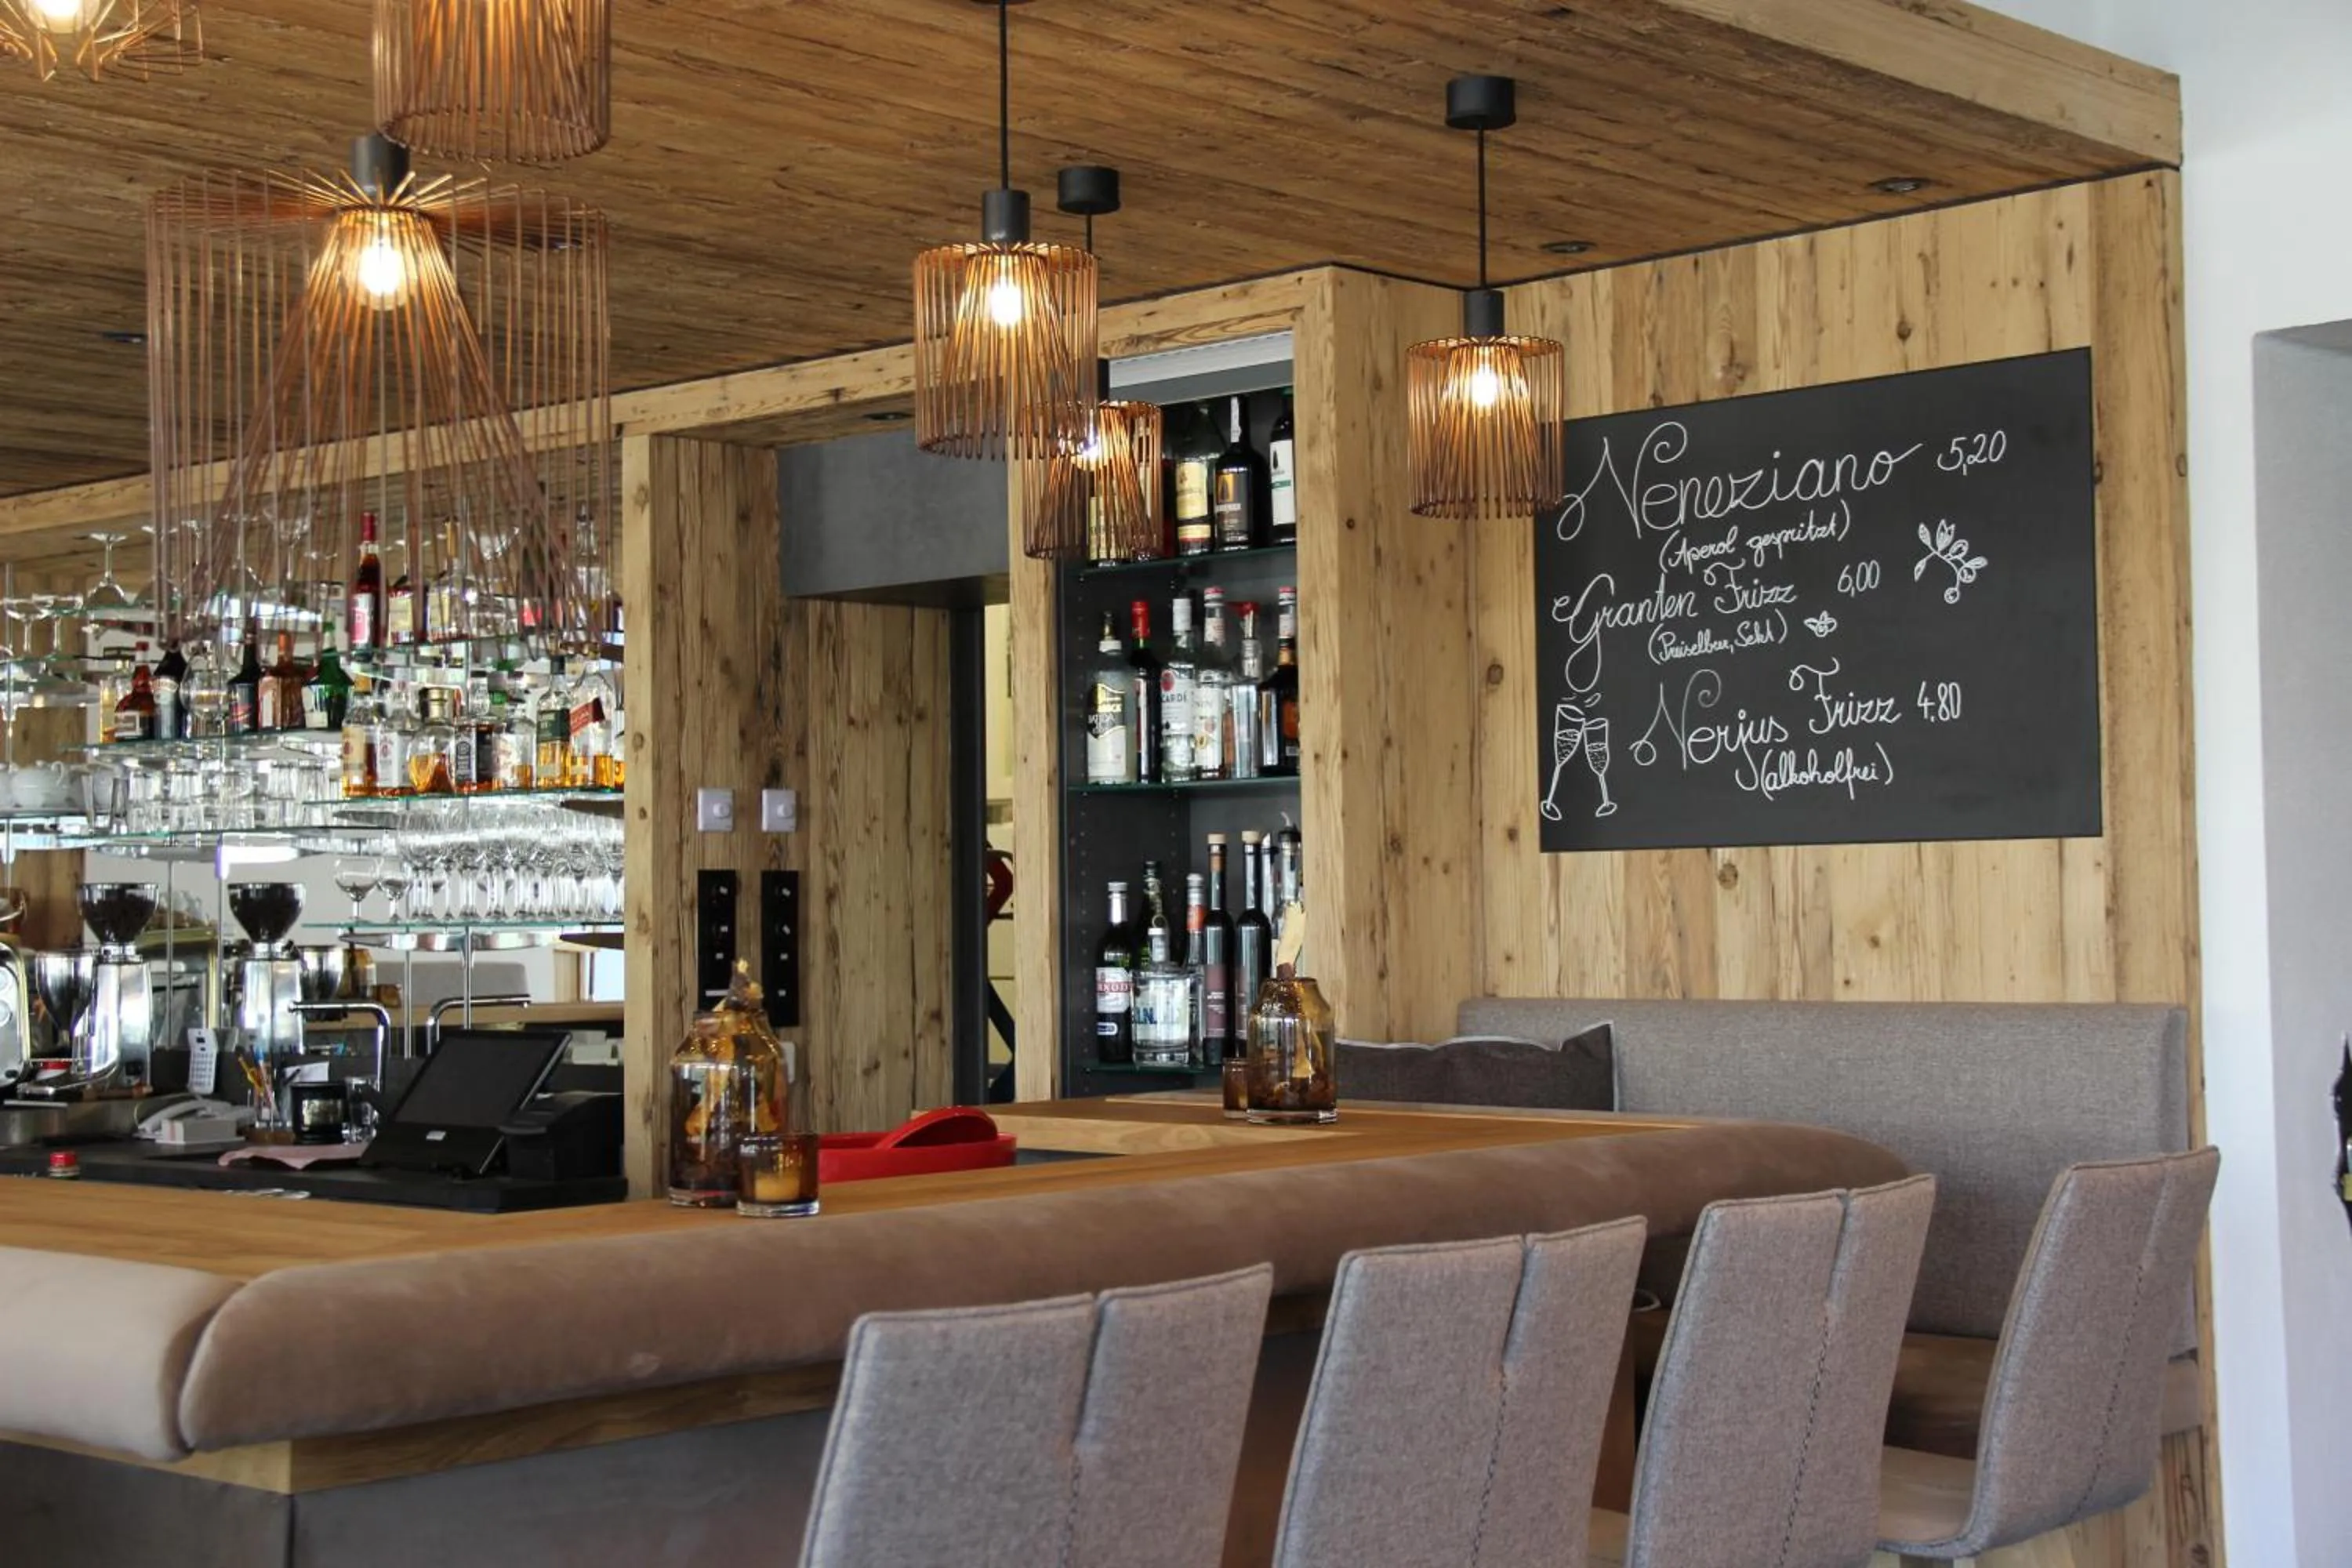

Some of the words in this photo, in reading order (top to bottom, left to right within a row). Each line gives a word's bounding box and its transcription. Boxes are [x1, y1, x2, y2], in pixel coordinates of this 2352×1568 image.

[1937, 430, 2007, 476] 5,20
[1659, 524, 1739, 575] (Aperol
[1746, 499, 1850, 568] gespritzt)
[1552, 572, 1700, 693] Granten
[1703, 557, 1798, 615] Frizz
[1838, 560, 1881, 597] 6,00
[1789, 657, 1902, 735] Frizz
[1761, 742, 1894, 801] (alkoholfrei)
